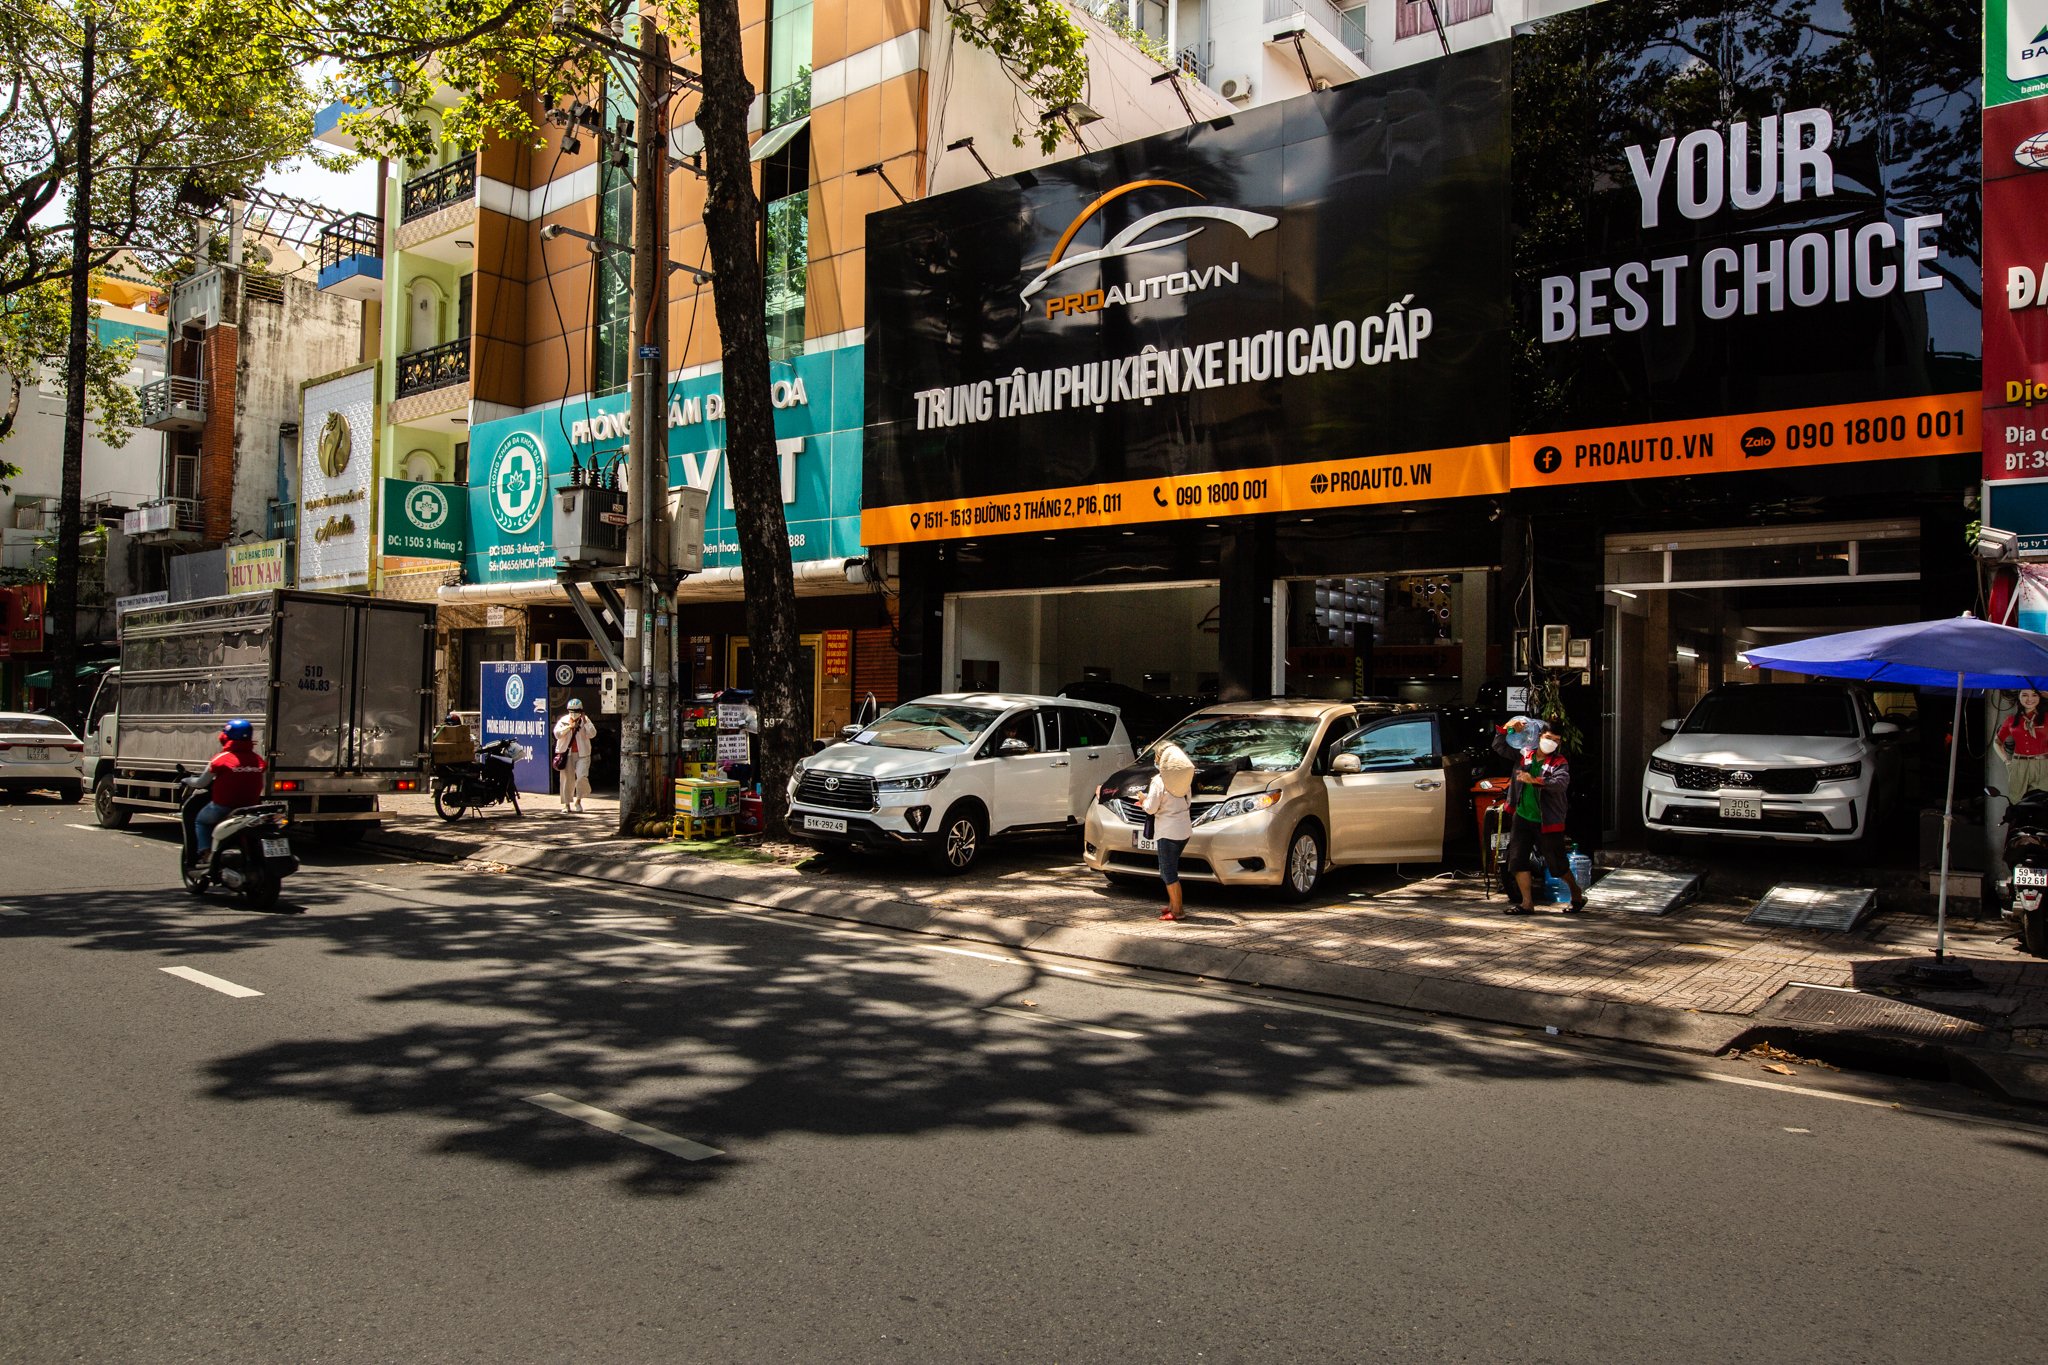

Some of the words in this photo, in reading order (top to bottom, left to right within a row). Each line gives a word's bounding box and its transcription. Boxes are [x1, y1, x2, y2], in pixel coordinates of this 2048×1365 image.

[1624, 107, 1835, 229] YOUR
[1046, 262, 1240, 320] PROAUTO.VN
[1540, 254, 1689, 344] BEST
[1701, 213, 1943, 320] CHOICE
[914, 380, 993, 431] TRUNG
[995, 366, 1051, 418] TÂM
[1054, 359, 1110, 413] PHỤ
[1111, 344, 1180, 406] KIỆN
[1182, 341, 1225, 392] XE
[1228, 329, 1284, 385] HƠI
[1287, 320, 1356, 376] CAO
[1360, 293, 1433, 366] CẤP
[668, 393, 702, 430] ÁM
[770, 377, 808, 410] OA
[1745, 436, 1771, 448] Zalo
[1785, 421, 1834, 450] 090
[1844, 415, 1906, 446] 1800
[1916, 409, 1964, 440] 001
[2005, 425, 2036, 447] Địa
[1575, 432, 1714, 468] PROAUTO.VN
[1176, 486, 1202, 506] 090
[1207, 481, 1239, 504] 1800
[1243, 479, 1268, 500] 001
[974, 501, 1011, 524] ĐƯỜNG
[1013, 505, 1021, 521] 3
[1024, 497, 1062, 519] THÁNG
[1064, 498, 1075, 518] 2,
[1103, 492, 1122, 513] Q11
[388, 534, 401, 546] ĐC:
[404, 535, 424, 548] 1505
[426, 538, 432, 548] 3
[433, 538, 455, 553] tháng
[458, 541, 462, 551] 2
[231, 565, 253, 586] HUY
[257, 561, 281, 583] NAM
[298, 679, 330, 692] 446.83
[304, 666, 323, 678] 51D
[1724, 808, 1756, 818] 836.96
[1731, 800, 1749, 808] 30G
